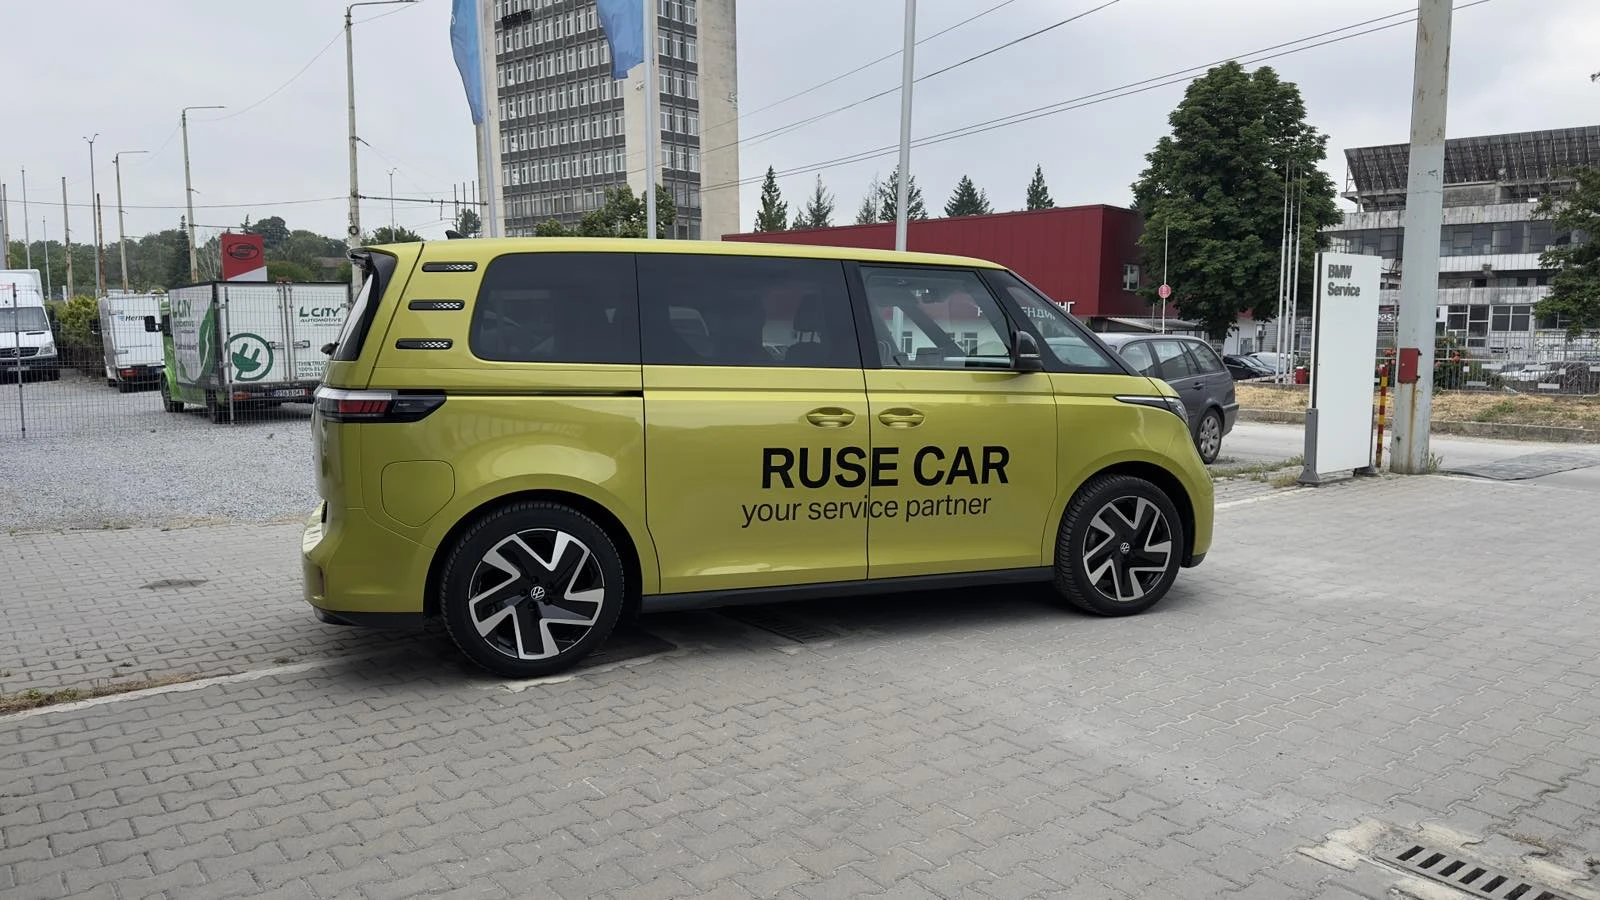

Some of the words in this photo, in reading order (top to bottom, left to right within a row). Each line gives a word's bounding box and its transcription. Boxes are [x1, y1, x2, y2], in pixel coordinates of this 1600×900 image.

[1328, 264, 1353, 279] BMW
[1328, 282, 1361, 296] Service
[311, 307, 341, 317] CITY
[1055, 301, 1076, 314] НГ
[761, 446, 899, 489] RUSE
[913, 446, 1010, 486] CAR
[741, 502, 802, 528] your
[807, 494, 898, 521] service
[905, 493, 992, 523] partner
